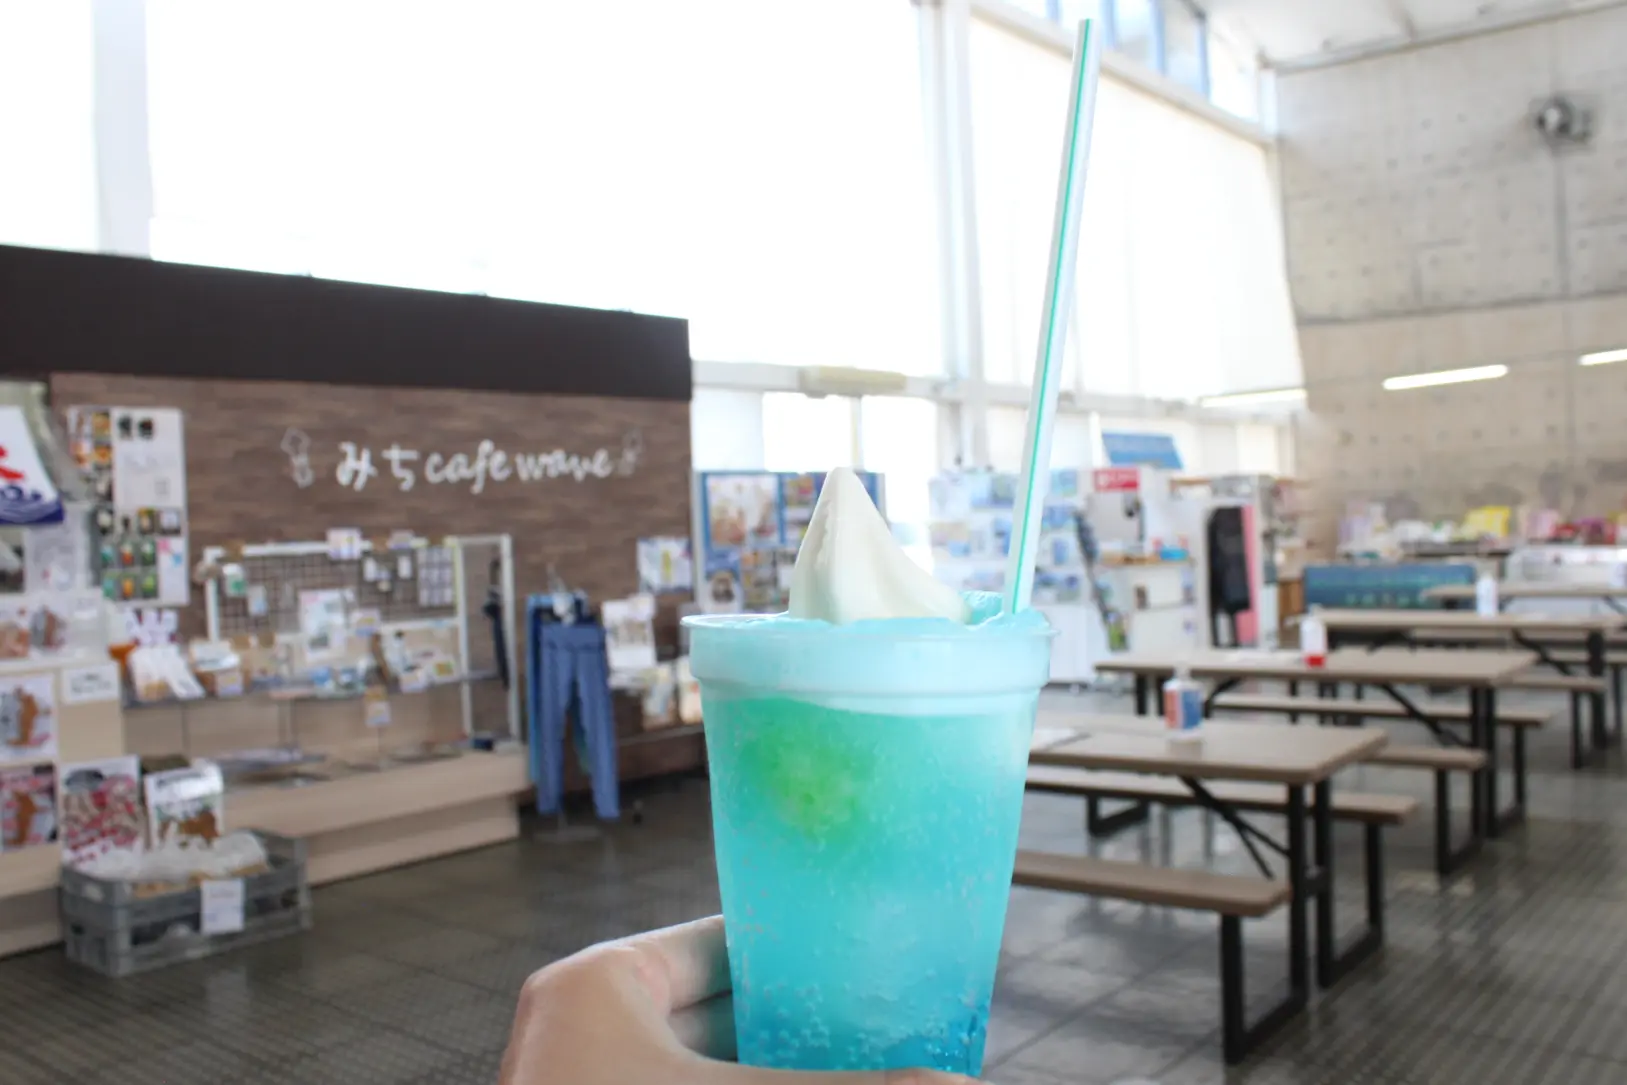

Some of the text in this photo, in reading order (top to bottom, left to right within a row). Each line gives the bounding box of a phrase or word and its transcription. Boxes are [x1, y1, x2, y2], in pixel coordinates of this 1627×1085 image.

[336, 439, 612, 494] みち cafe wave
